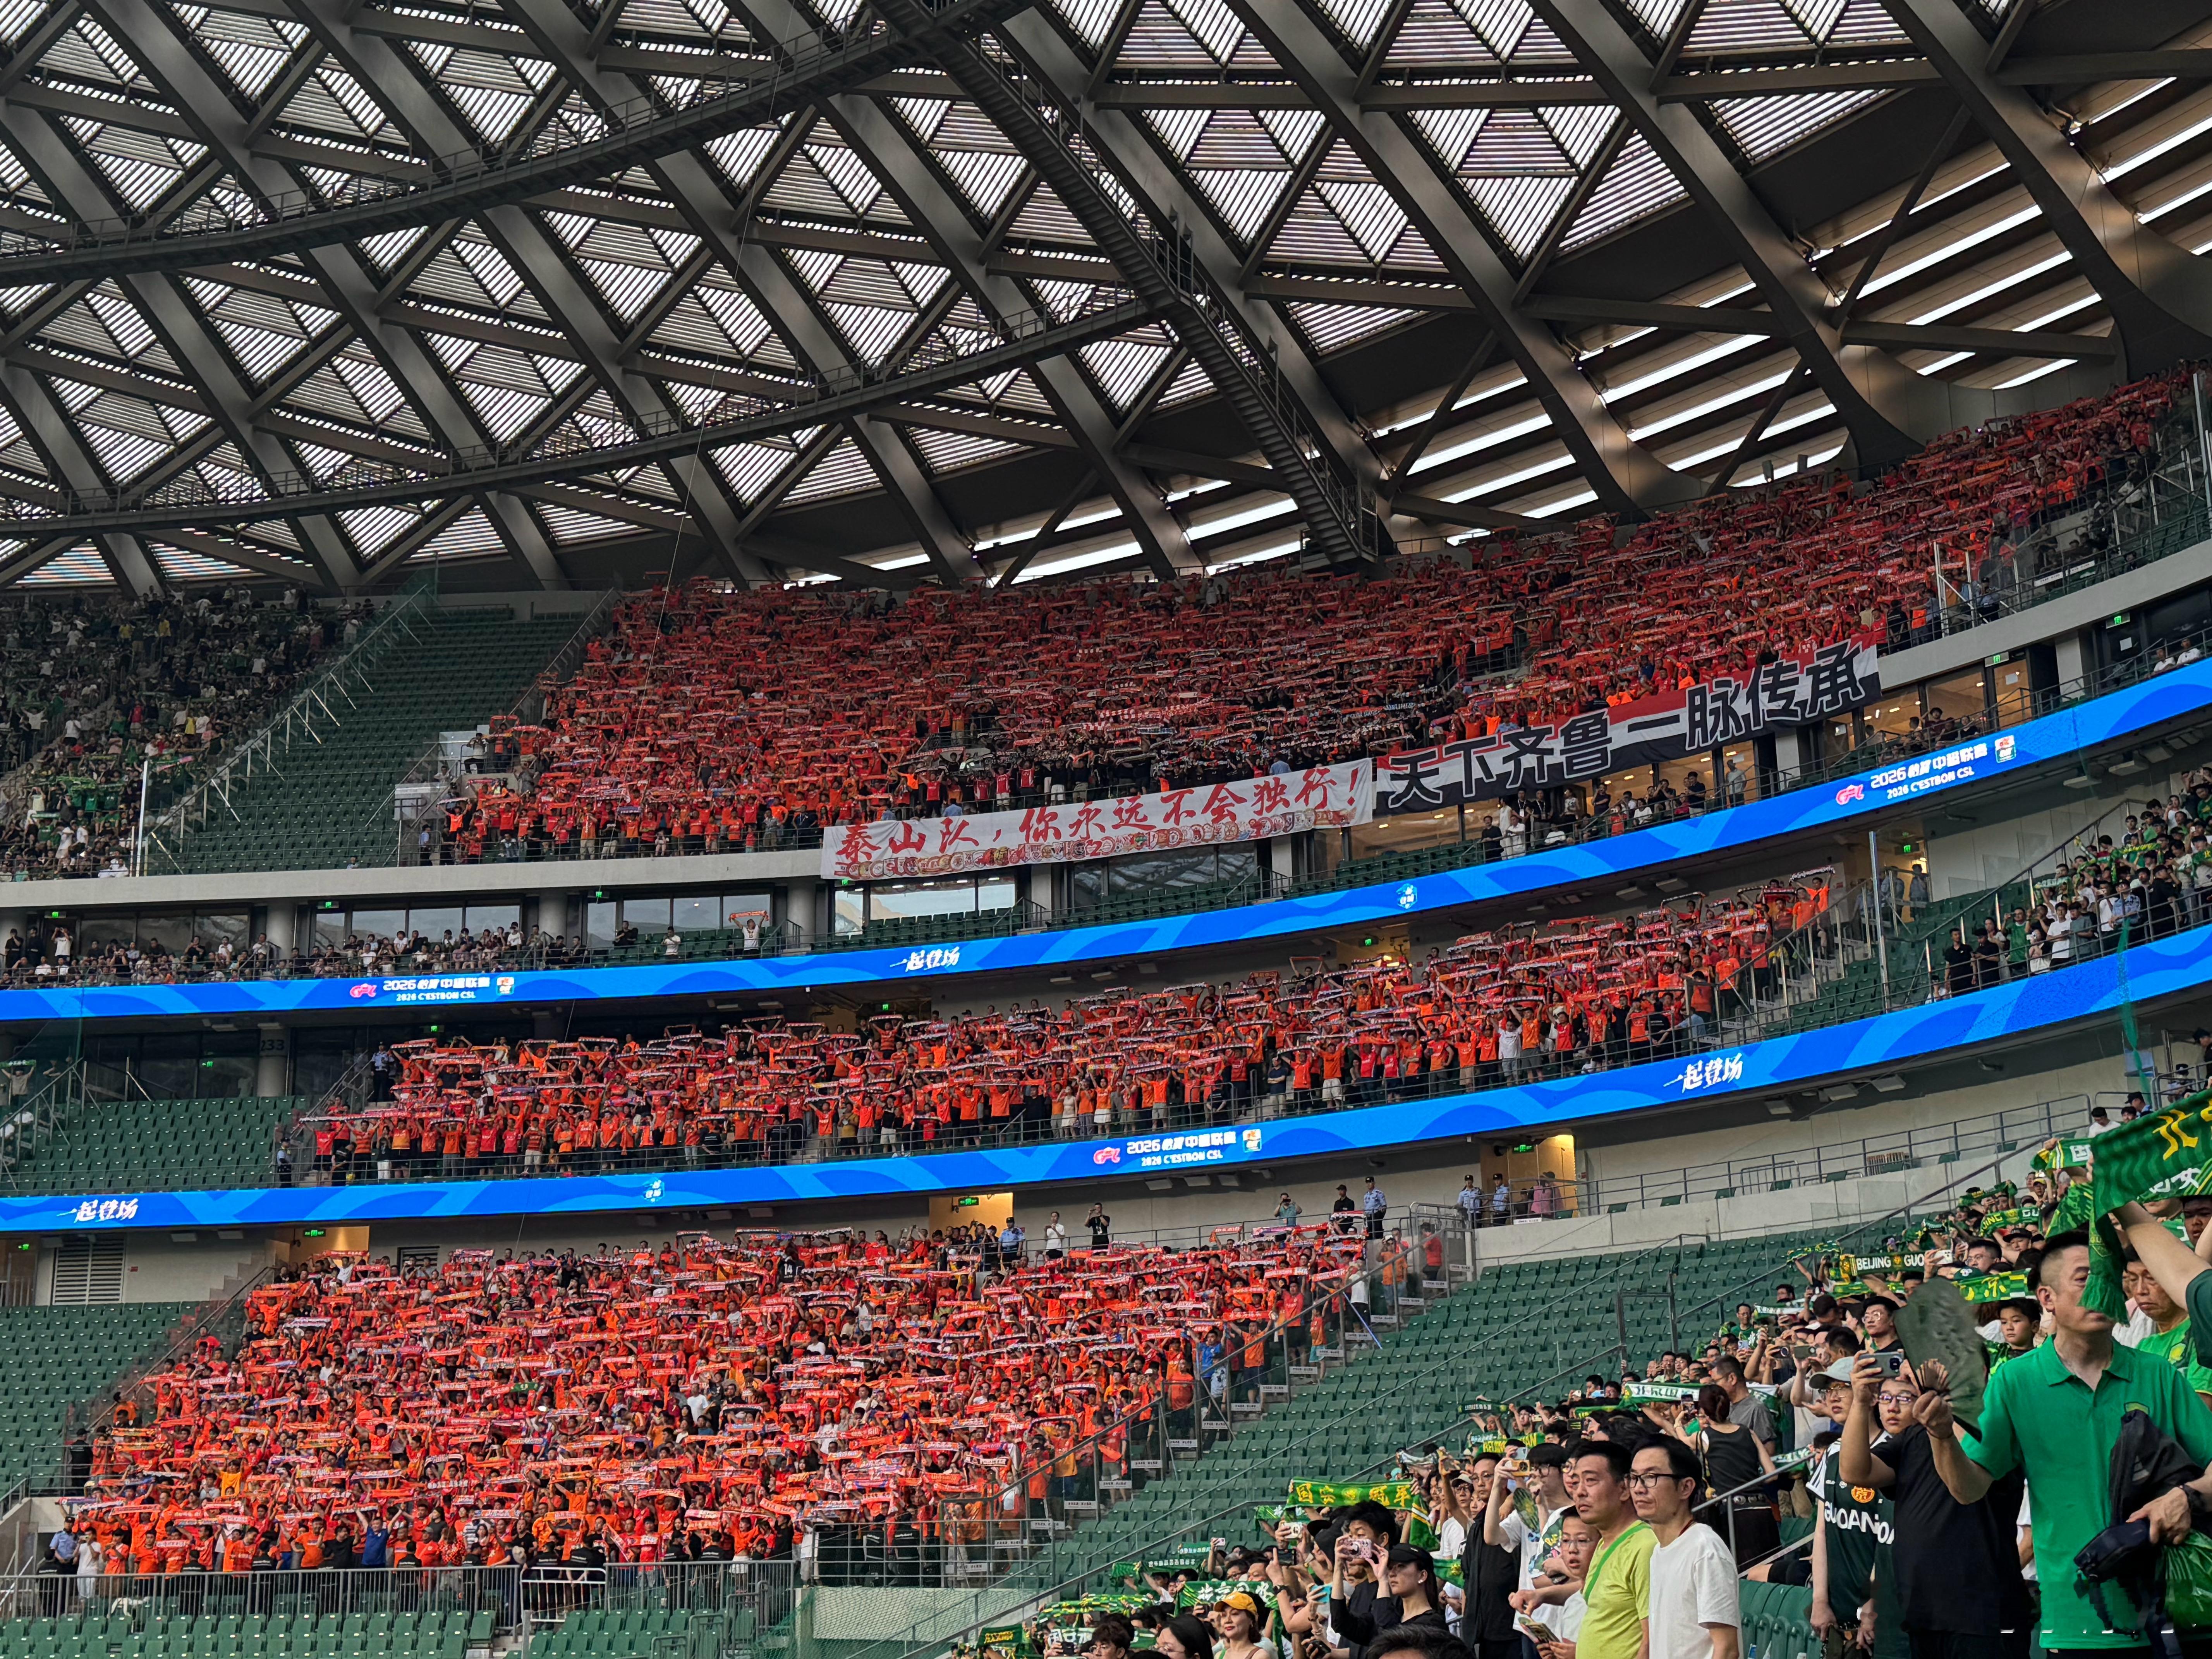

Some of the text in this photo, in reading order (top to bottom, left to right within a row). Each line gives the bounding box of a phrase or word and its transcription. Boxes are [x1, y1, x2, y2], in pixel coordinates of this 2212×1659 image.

[1389, 643, 1863, 807] 天下齐鲁一脉传承
[1887, 786, 1909, 799] 2026
[1663, 1053, 1743, 1094] 一起登场
[1856, 1254, 1925, 1271] BEIJING GUO
